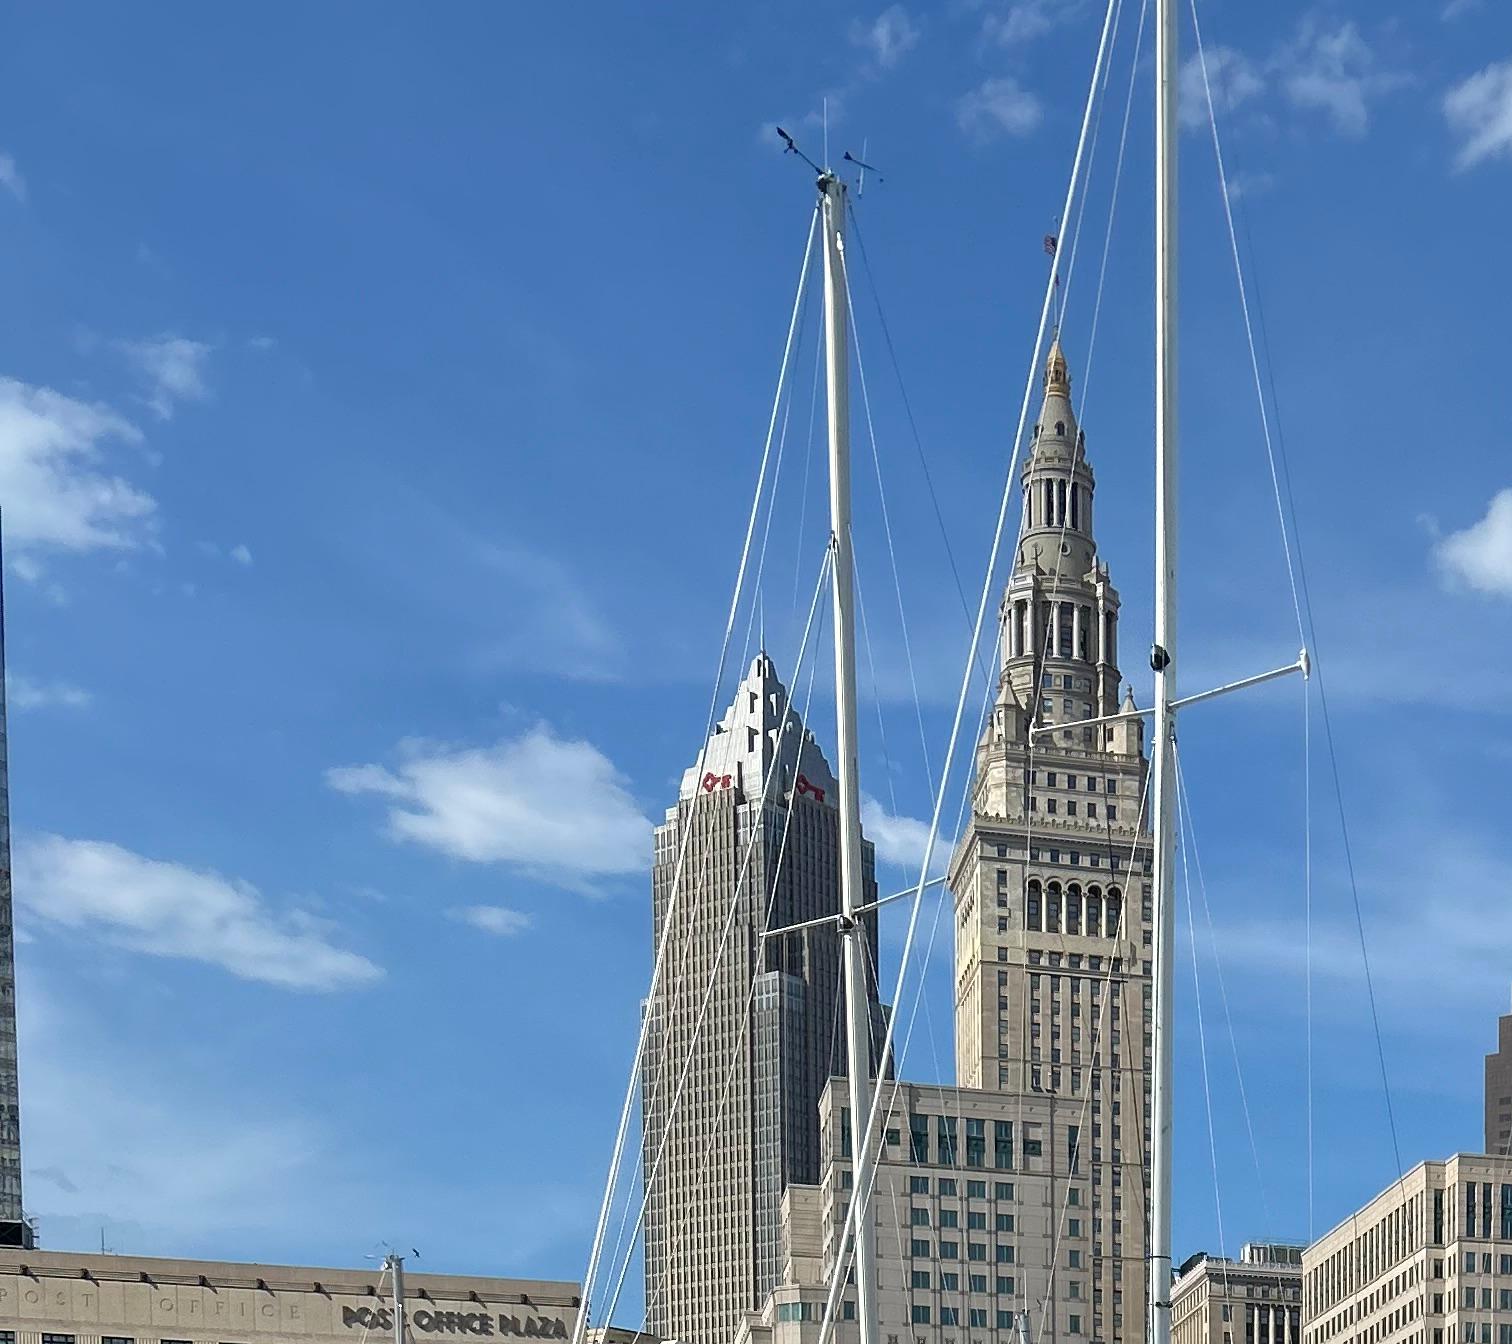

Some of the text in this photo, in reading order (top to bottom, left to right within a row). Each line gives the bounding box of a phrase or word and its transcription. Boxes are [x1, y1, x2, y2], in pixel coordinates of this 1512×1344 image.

[159, 1298, 300, 1320] OFFICE
[414, 1310, 495, 1337] OFFICE
[499, 1314, 569, 1340] PLAZA
